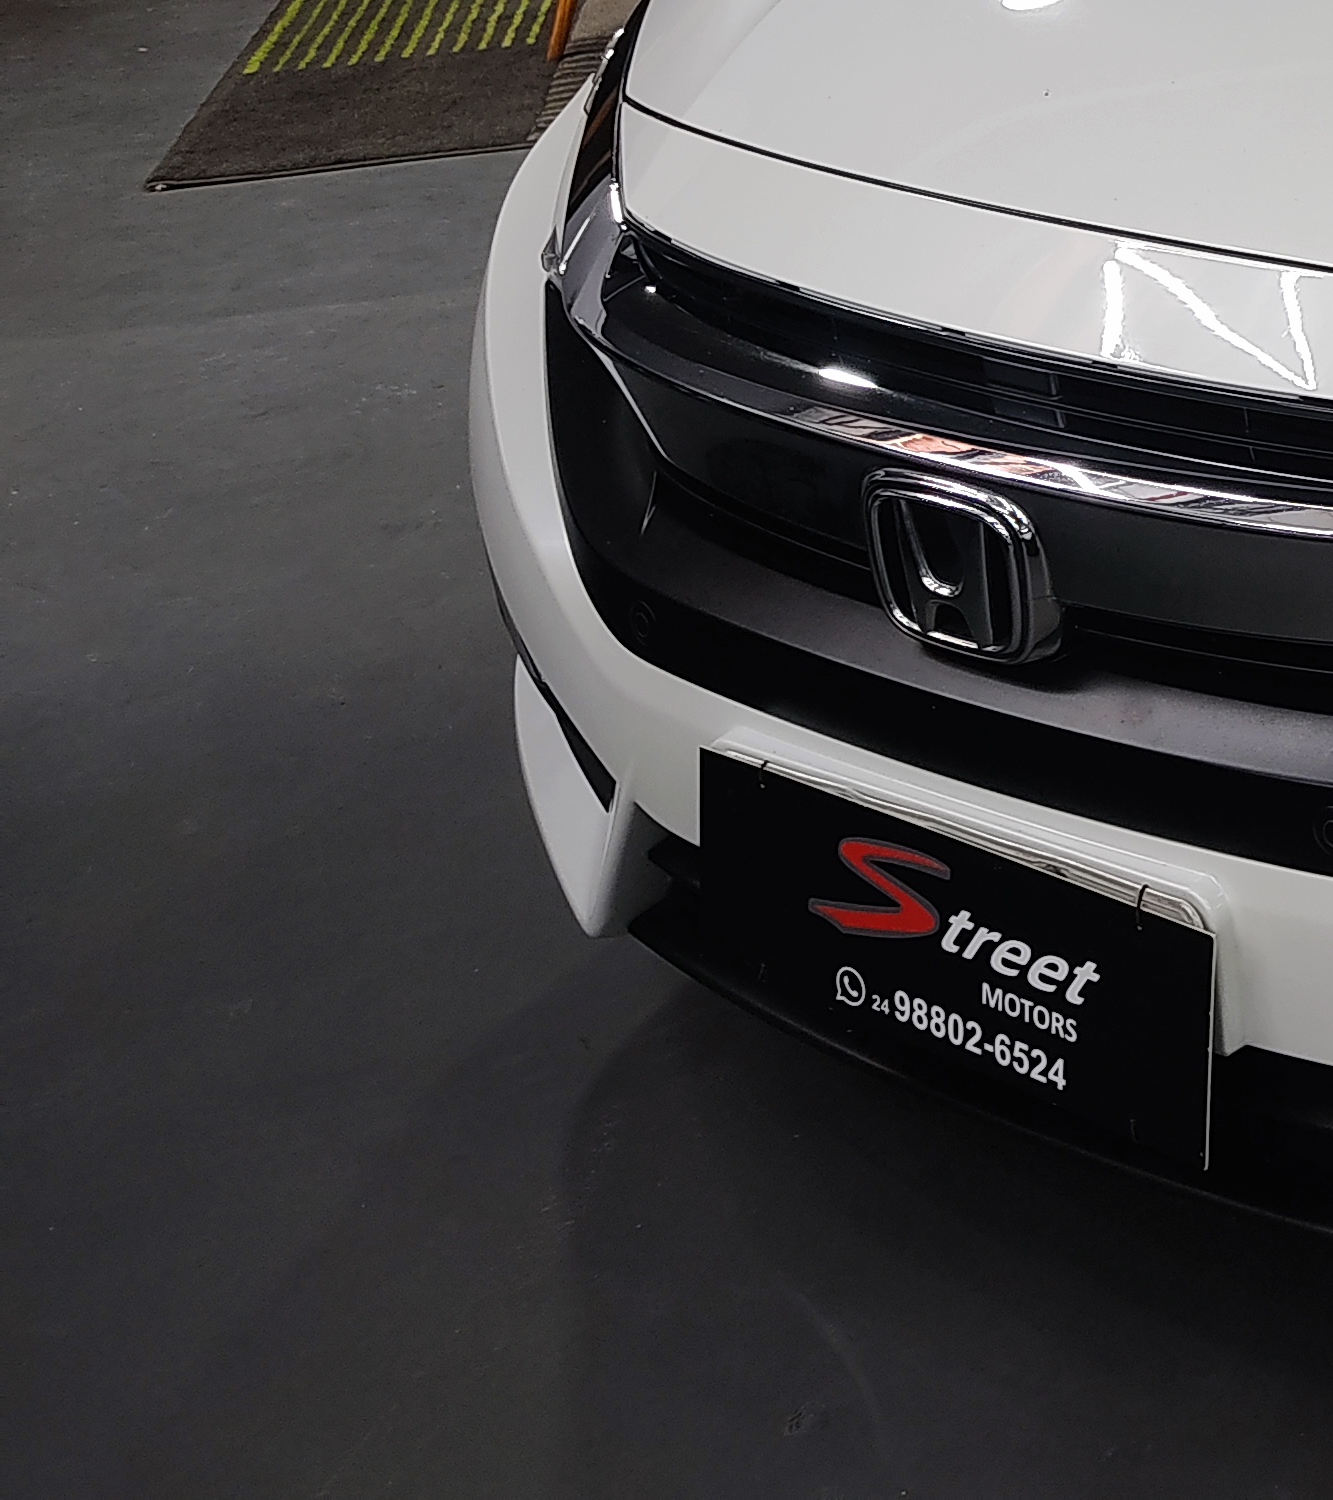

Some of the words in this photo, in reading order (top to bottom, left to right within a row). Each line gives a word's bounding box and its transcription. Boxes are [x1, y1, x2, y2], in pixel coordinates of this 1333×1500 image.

[808, 837, 1100, 1005] Street
[871, 994, 890, 1015] 24
[892, 989, 1067, 1091] 98802-6524
[980, 982, 1078, 1043] MOTORS
